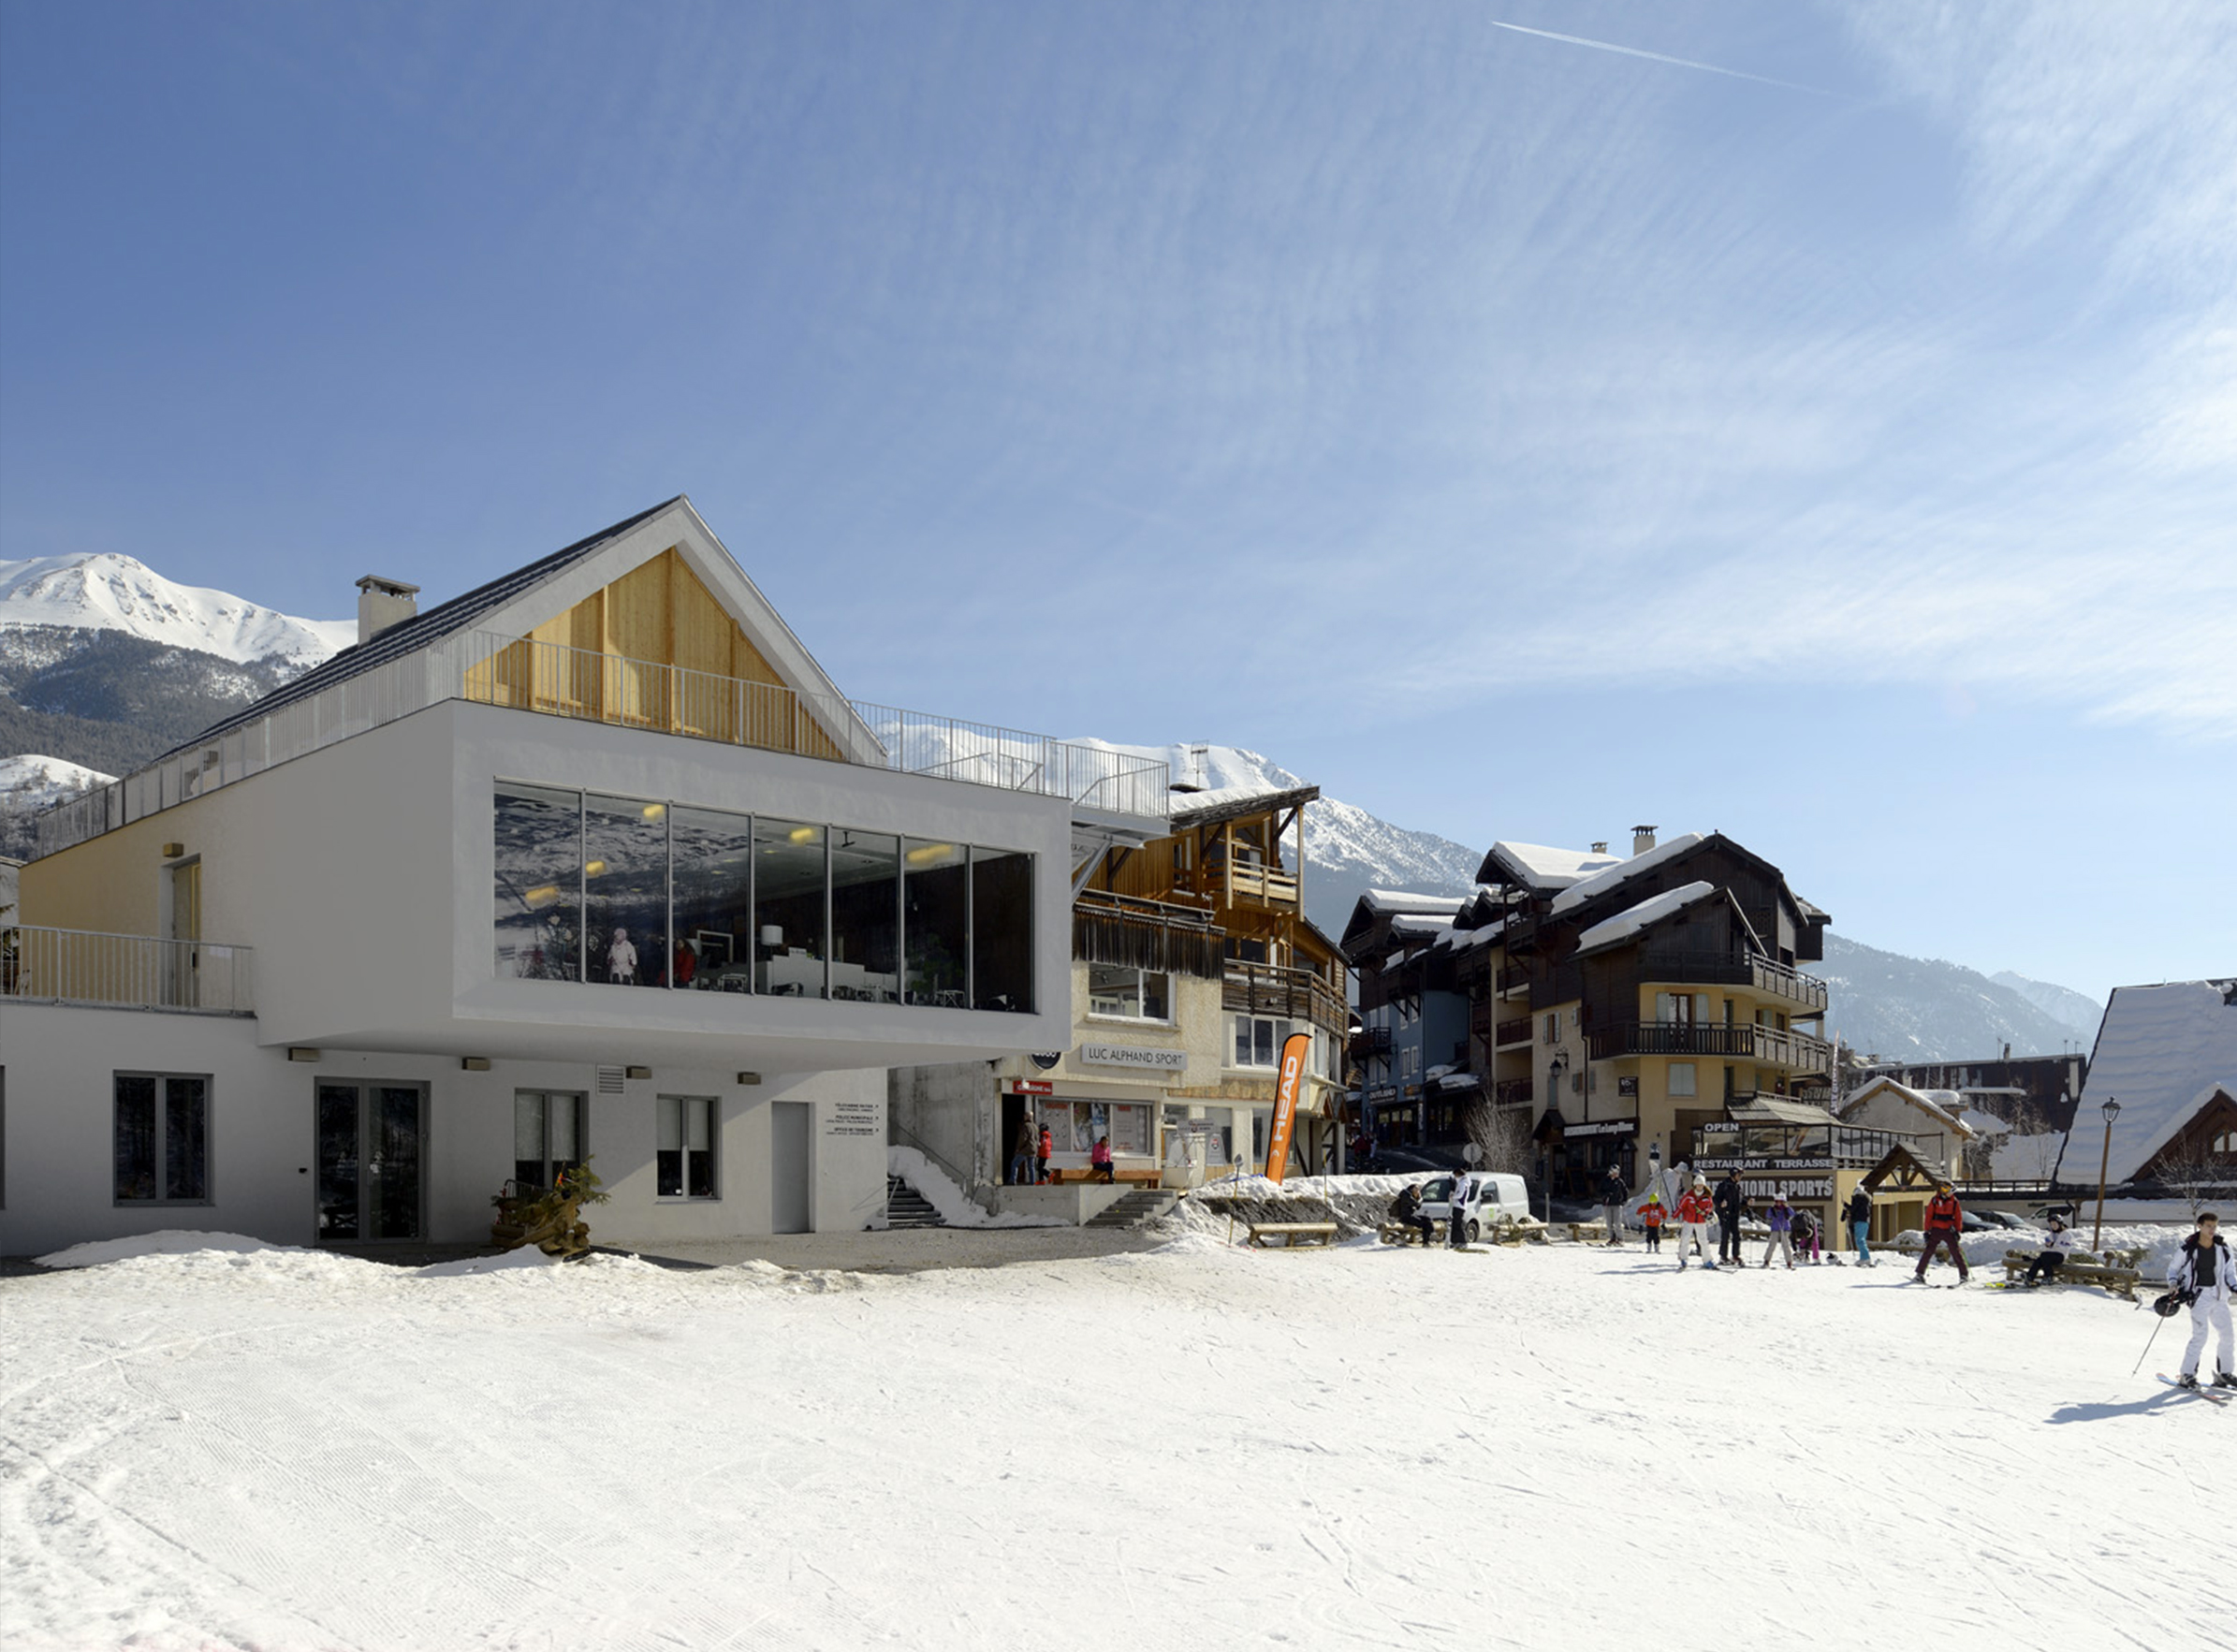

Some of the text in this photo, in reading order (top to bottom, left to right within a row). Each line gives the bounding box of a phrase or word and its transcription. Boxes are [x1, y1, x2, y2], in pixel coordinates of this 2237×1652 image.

[1089, 1047, 1182, 1065] LUC ALPHAND SPORT
[1274, 1056, 1297, 1142] HEAD
[1704, 1123, 1739, 1132] OPEN
[1693, 1158, 1833, 1168] RESTAURANT TERRASSE
[1779, 1179, 1833, 1196] SPORTS
